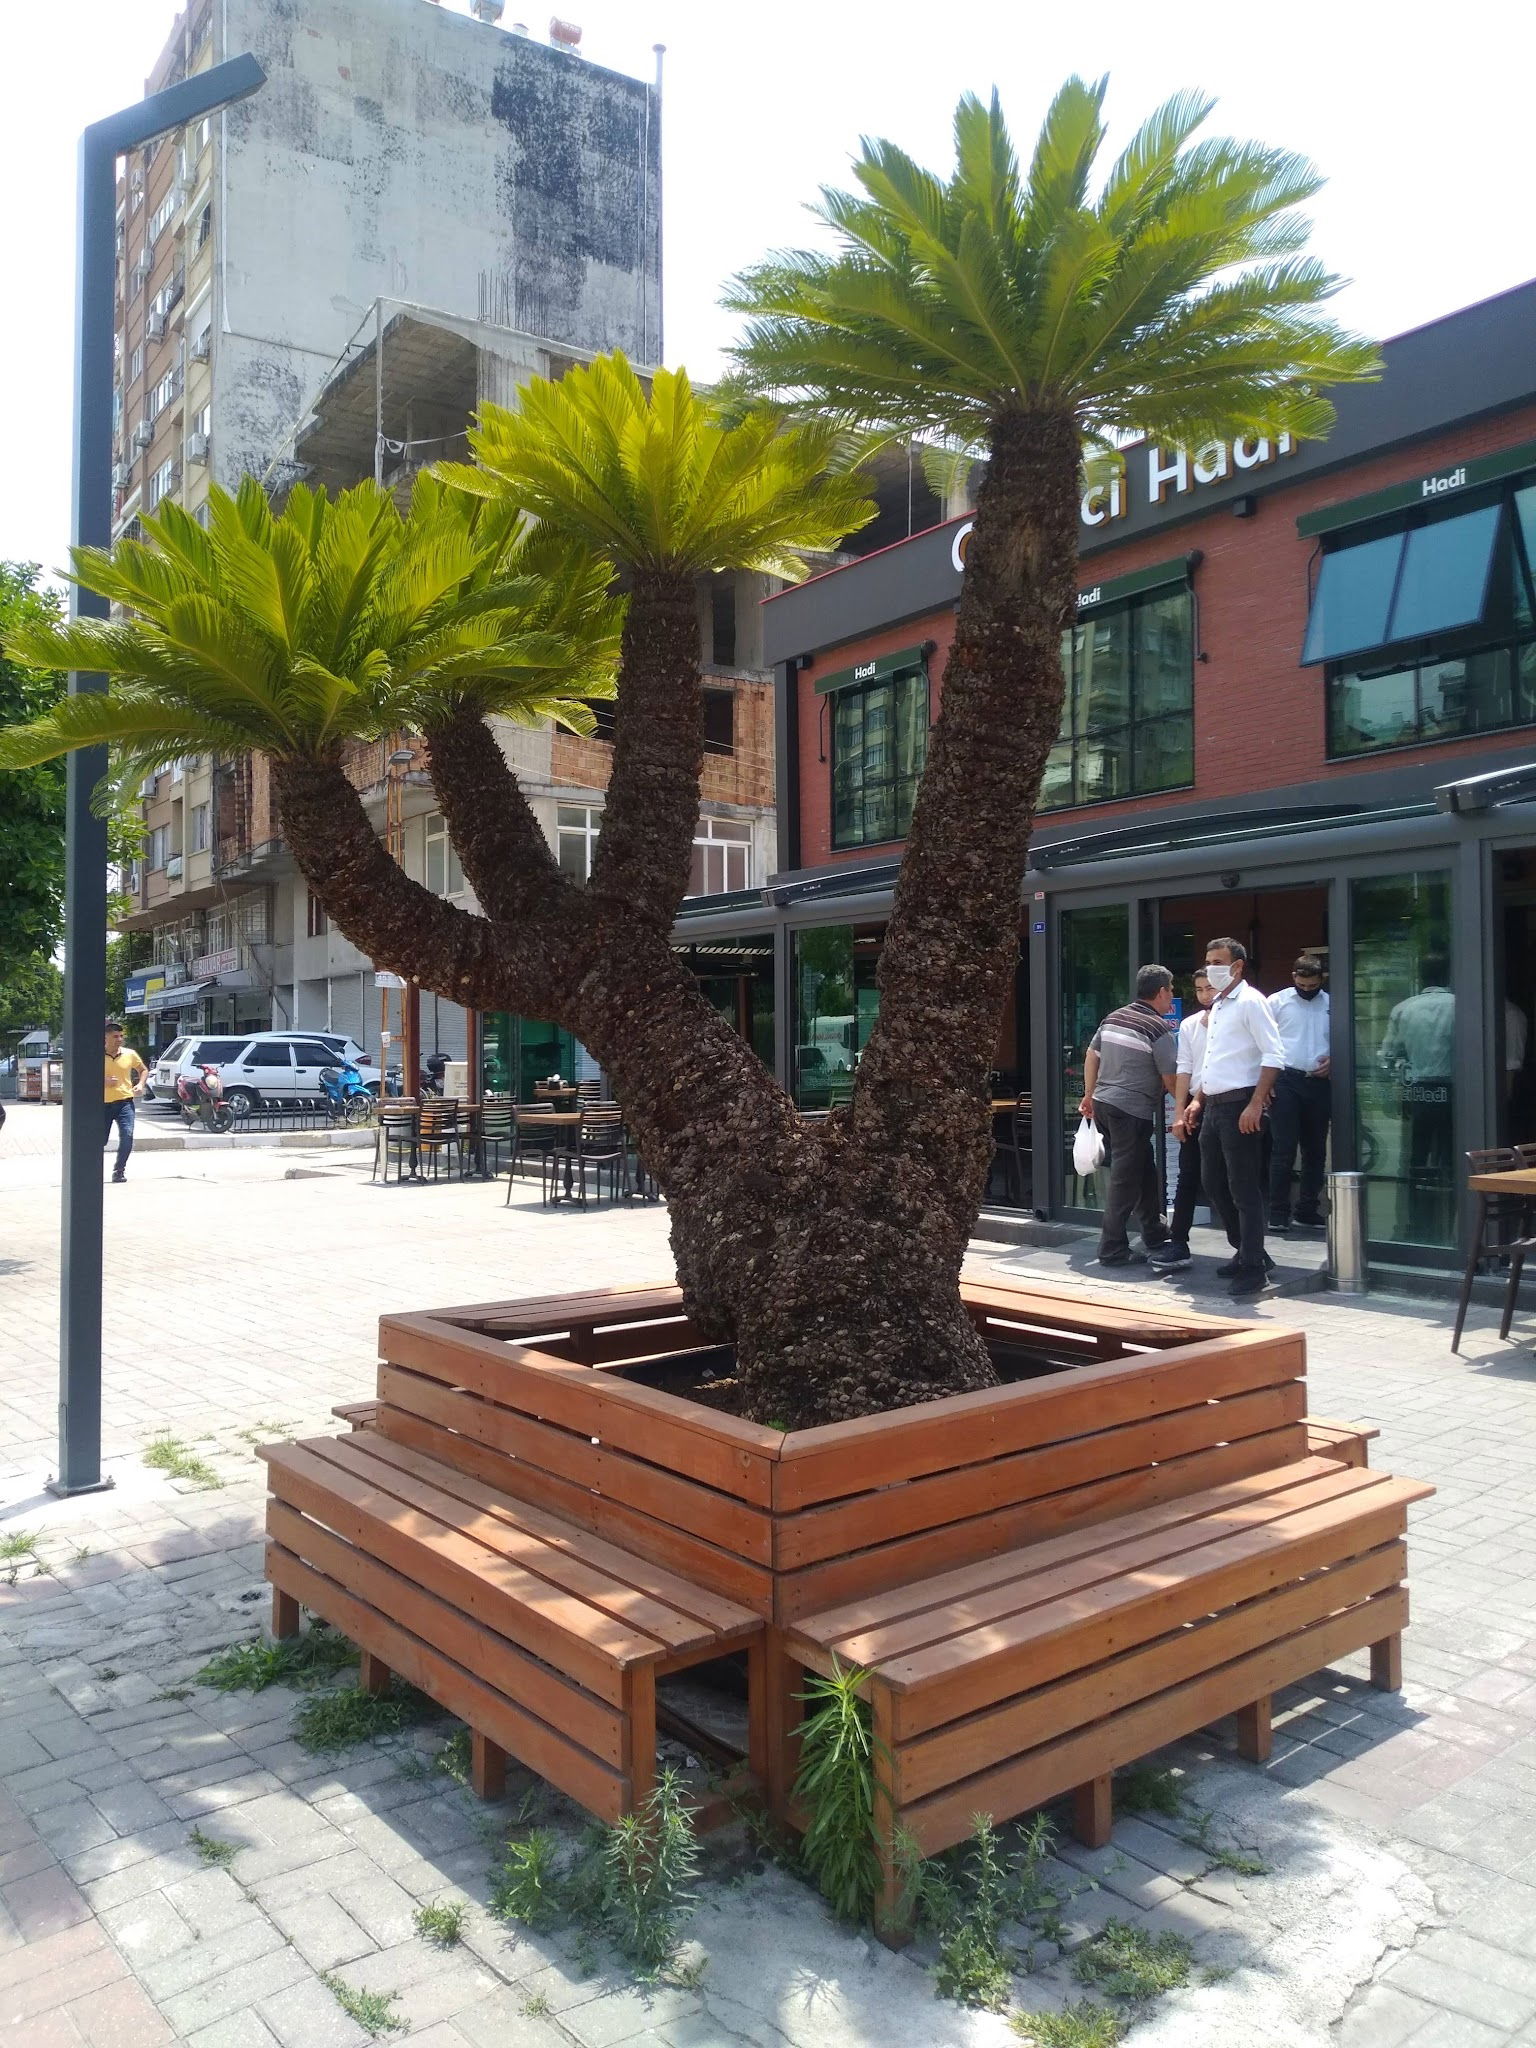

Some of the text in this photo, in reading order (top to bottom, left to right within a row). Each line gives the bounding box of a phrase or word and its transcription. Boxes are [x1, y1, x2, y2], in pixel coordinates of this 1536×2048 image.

[1422, 467, 1466, 497] Hadi
[854, 661, 876, 680] Hadi
[1413, 1086, 1447, 1102] Hadi
